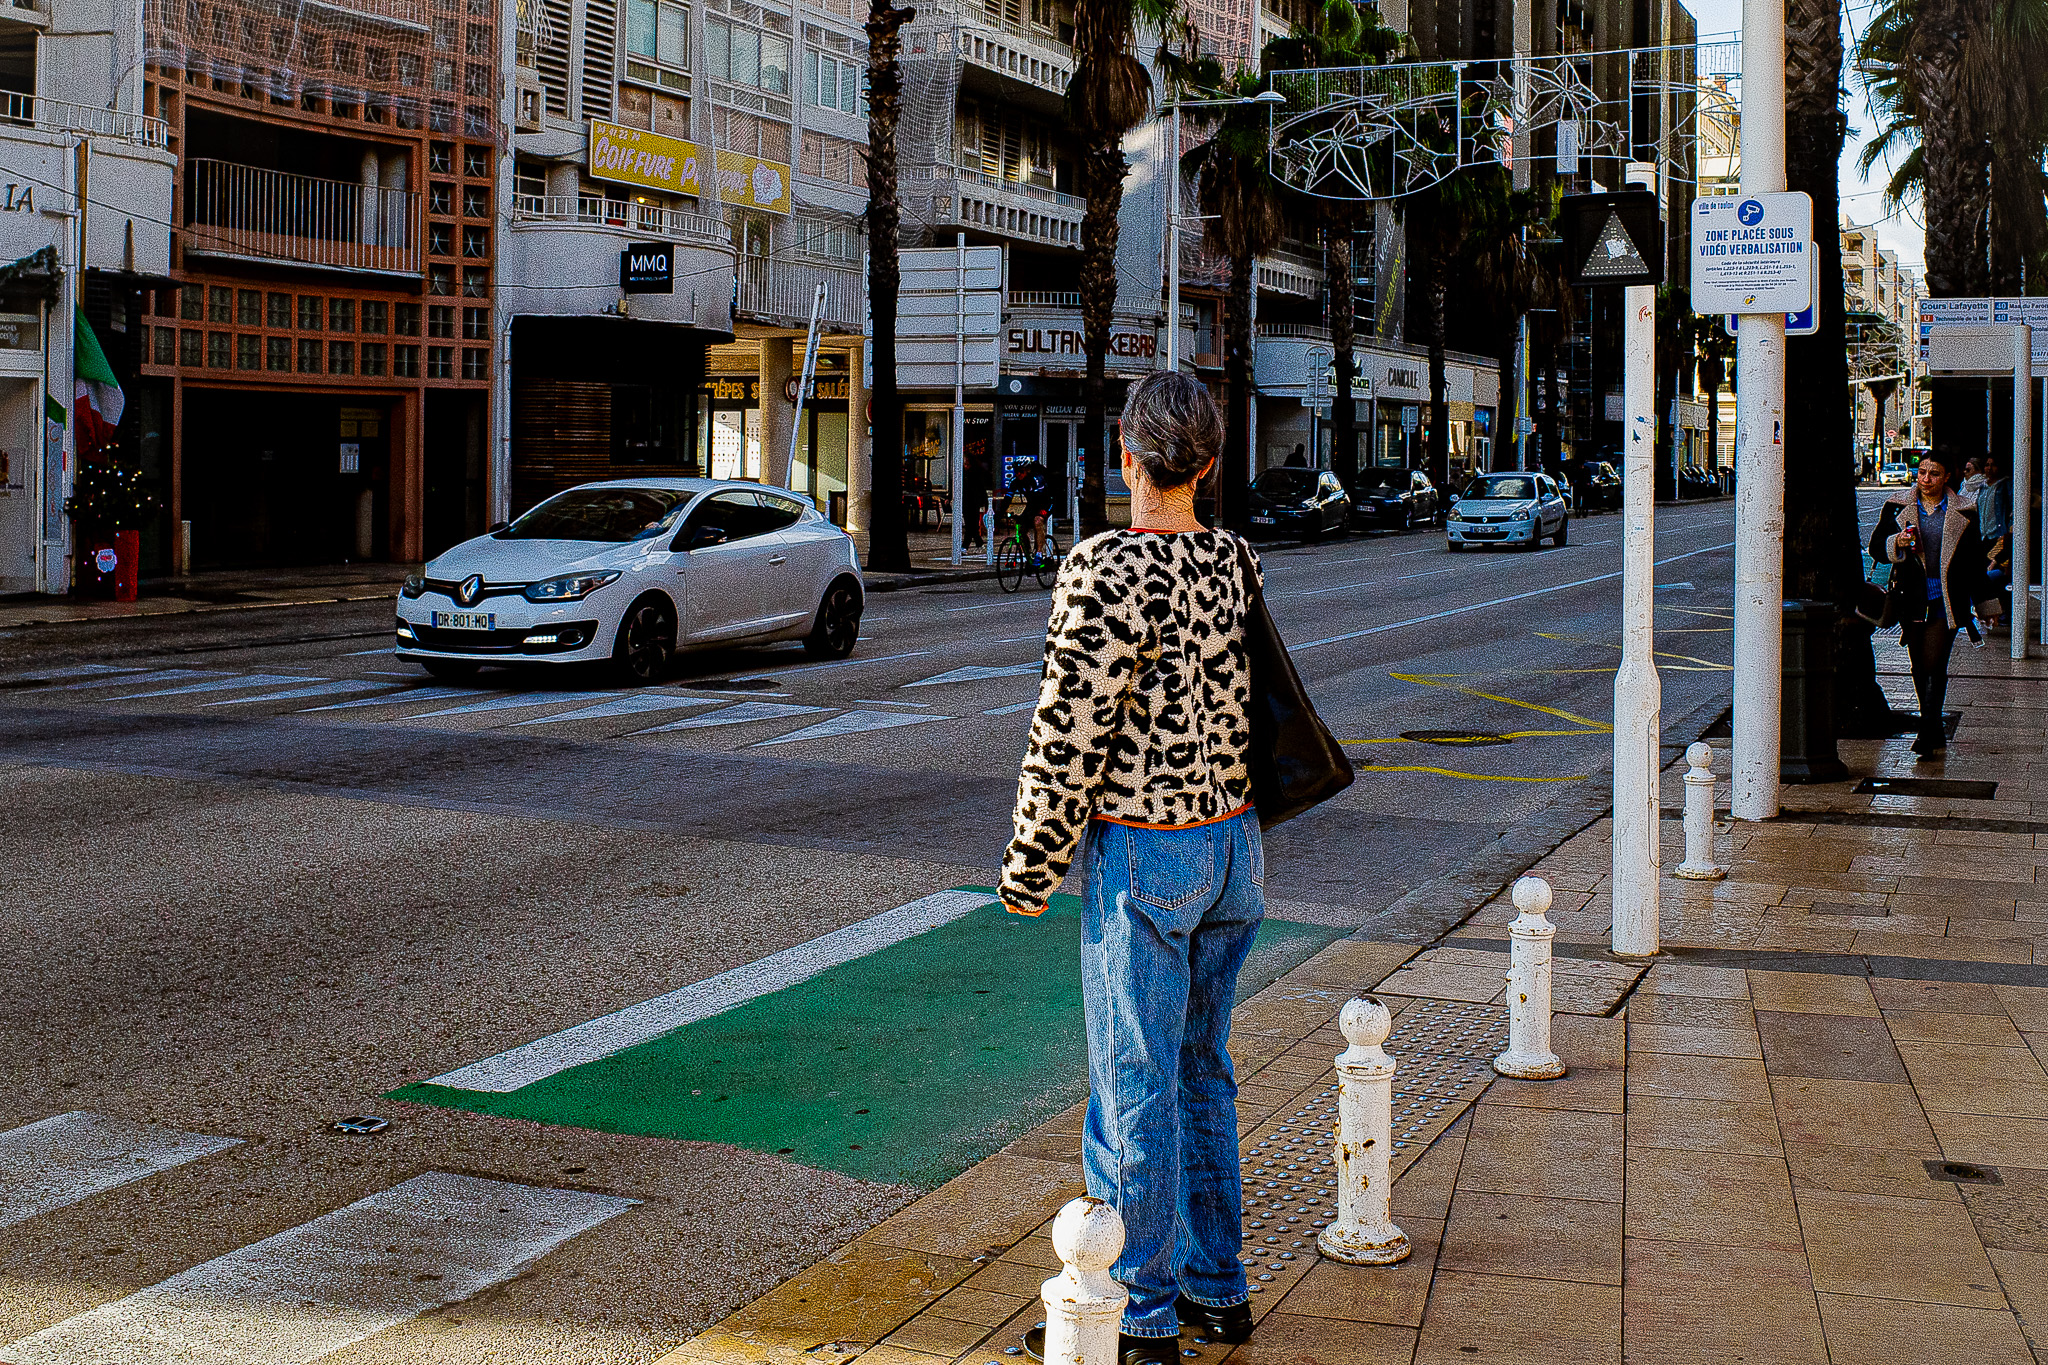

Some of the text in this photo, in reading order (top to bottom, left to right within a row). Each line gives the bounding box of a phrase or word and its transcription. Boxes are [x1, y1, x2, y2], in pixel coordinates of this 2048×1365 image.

[594, 136, 676, 180] COIFFURE
[0, 183, 34, 214] IA
[1705, 227, 1794, 242] ZONE PLACÉE SOUS
[1699, 241, 1803, 256] VIDÉO VERBALISATION
[630, 254, 668, 272] MMQ
[1920, 301, 1989, 311] Cours Lafayette
[1007, 328, 1156, 358] SULTAN KEBAB
[1387, 366, 1419, 391] CANICULE
[972, 417, 989, 425] STOP
